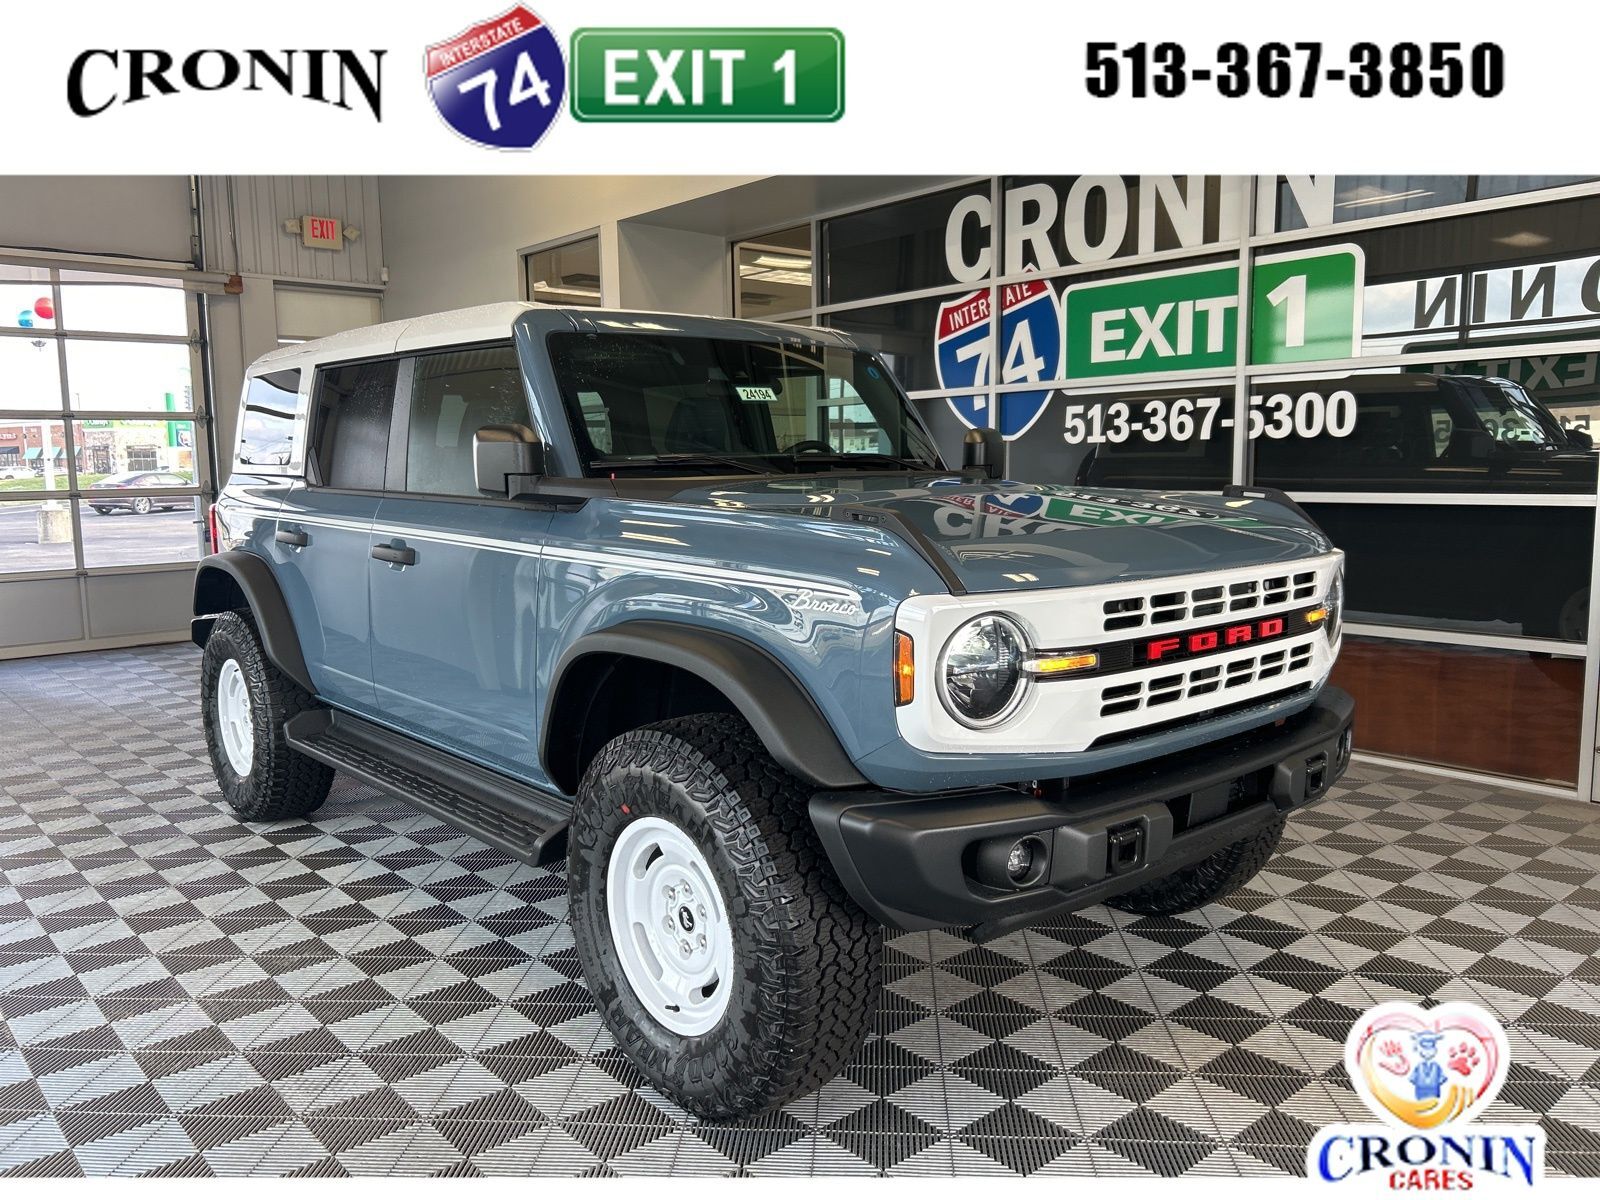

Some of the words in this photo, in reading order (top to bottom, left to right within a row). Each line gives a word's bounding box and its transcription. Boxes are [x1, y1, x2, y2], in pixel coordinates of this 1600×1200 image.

[311, 218, 336, 240] EXIT
[945, 173, 1334, 283] CRONIN
[949, 283, 1032, 331] INTERATE
[1090, 295, 1239, 364] EXIT
[1266, 274, 1307, 348] 1
[956, 319, 1045, 411] 74
[743, 389, 772, 400] 24194
[1063, 391, 1357, 444] 513-367-5300
[785, 588, 861, 616] Bronco
[1147, 618, 1283, 660] FORD
